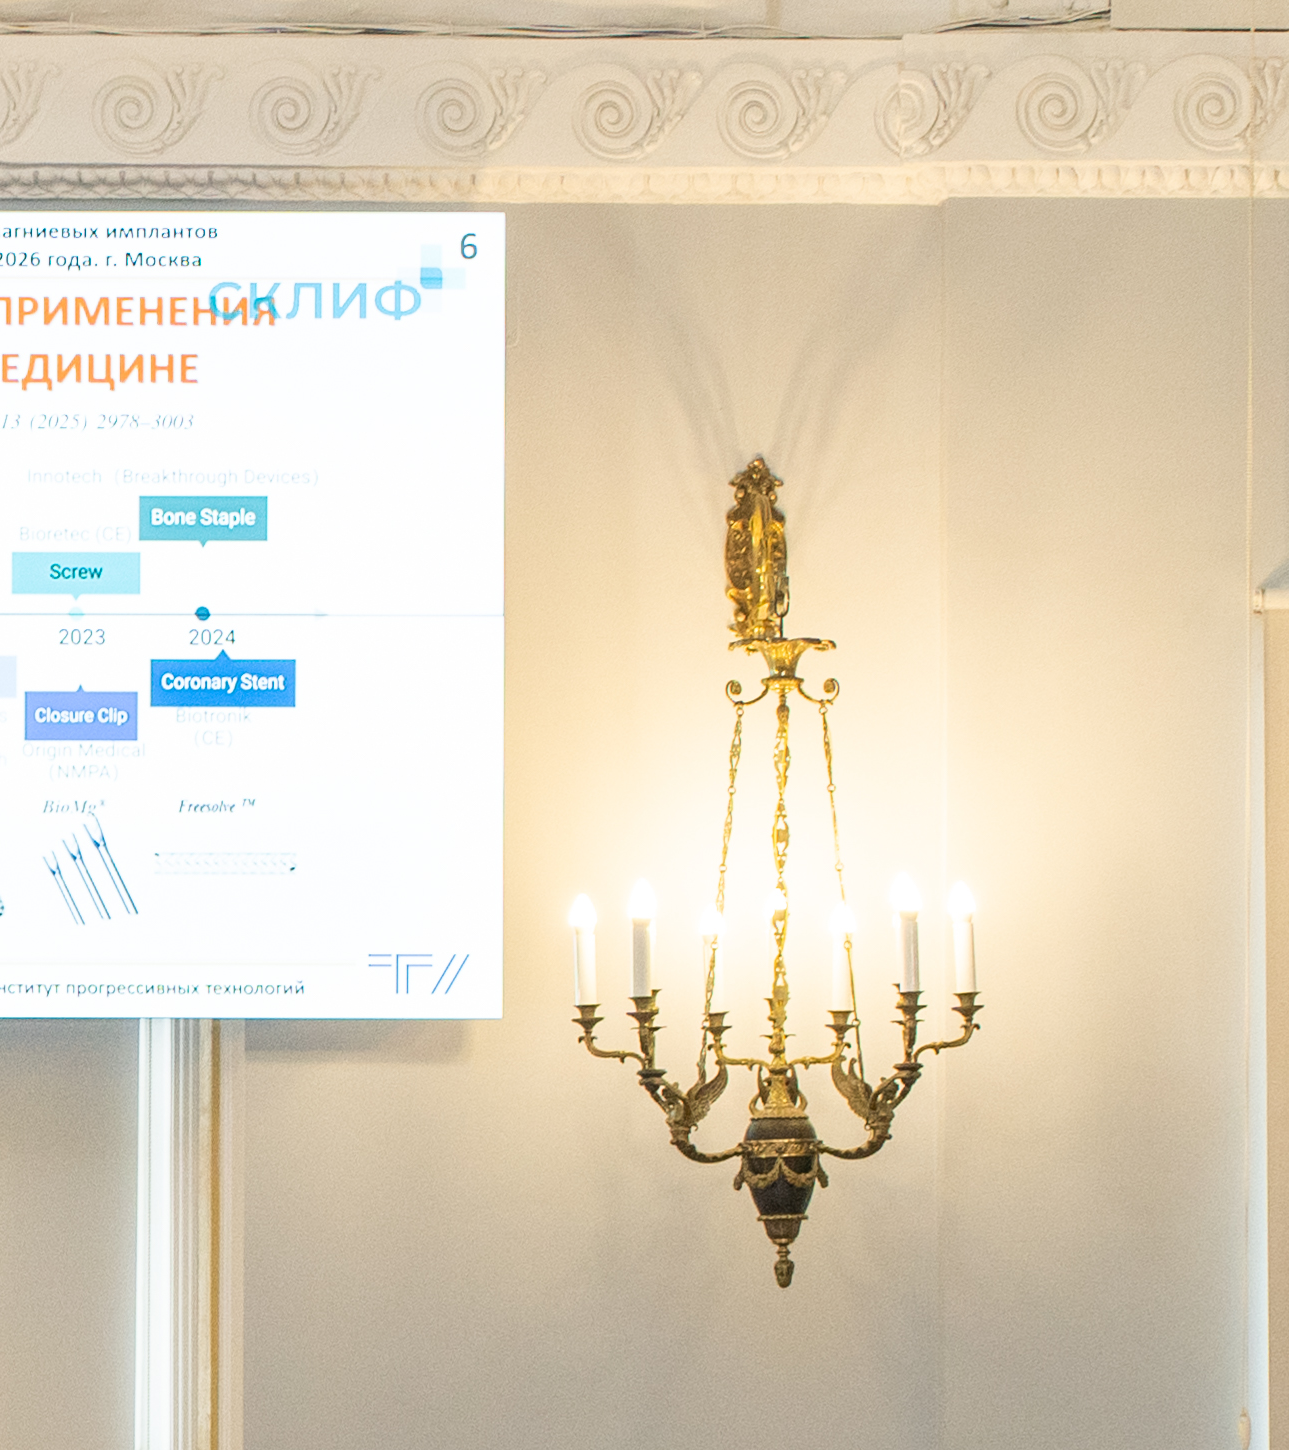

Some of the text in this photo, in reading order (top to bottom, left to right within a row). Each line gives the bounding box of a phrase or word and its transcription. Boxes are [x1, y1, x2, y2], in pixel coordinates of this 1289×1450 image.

[106, 226, 219, 239] имплантов
[460, 232, 478, 260] 6
[47, 254, 98, 272] года.
[105, 255, 117, 267] г.
[125, 251, 203, 267] Москва
[209, 280, 424, 321] СКЛИФ
[0, 413, 22, 430] 13
[28, 413, 89, 432] (2025)
[151, 507, 257, 529] Bone Staple
[49, 562, 104, 580] Screw
[58, 628, 106, 646] 2023
[188, 628, 236, 646] 2024
[161, 672, 285, 694] Coronary Stent
[34, 707, 128, 726] Closure Clip
[66, 983, 201, 998] прогрессивных
[206, 980, 307, 996] технологий
